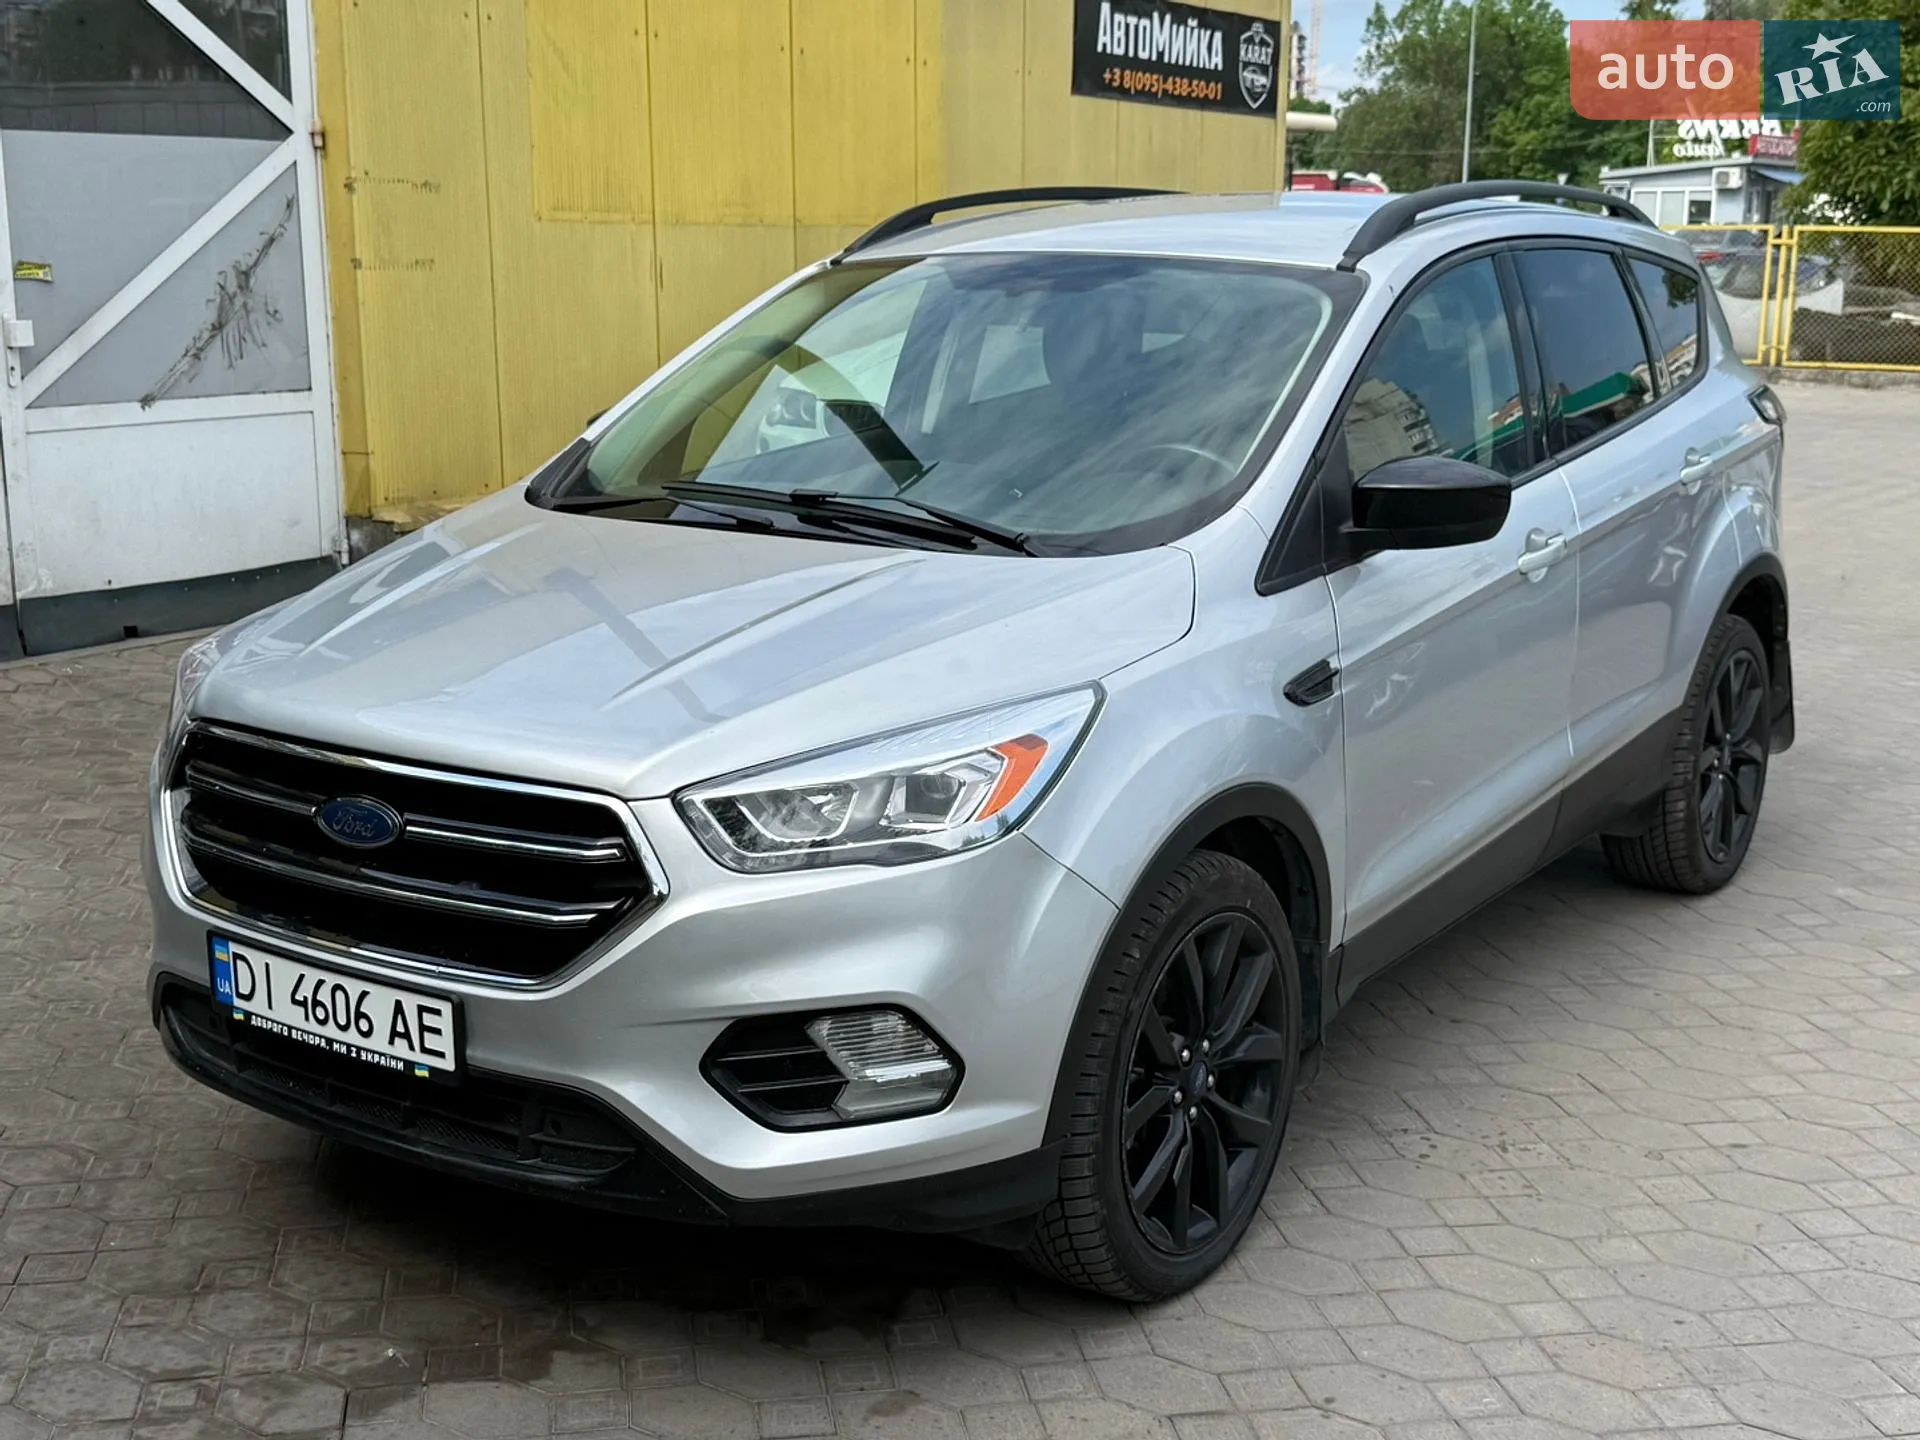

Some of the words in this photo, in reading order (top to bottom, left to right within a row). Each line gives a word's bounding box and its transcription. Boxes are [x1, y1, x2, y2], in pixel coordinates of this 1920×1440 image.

[332, 806, 379, 837] Ford
[217, 976, 232, 996] UA
[231, 950, 273, 1011] DI
[290, 973, 374, 1039] 4606
[388, 998, 447, 1059] AE
[250, 1015, 288, 1036] ДОБРОГО
[333, 1041, 347, 1054] МИ
[360, 1050, 404, 1071] УКРАЇНИ
